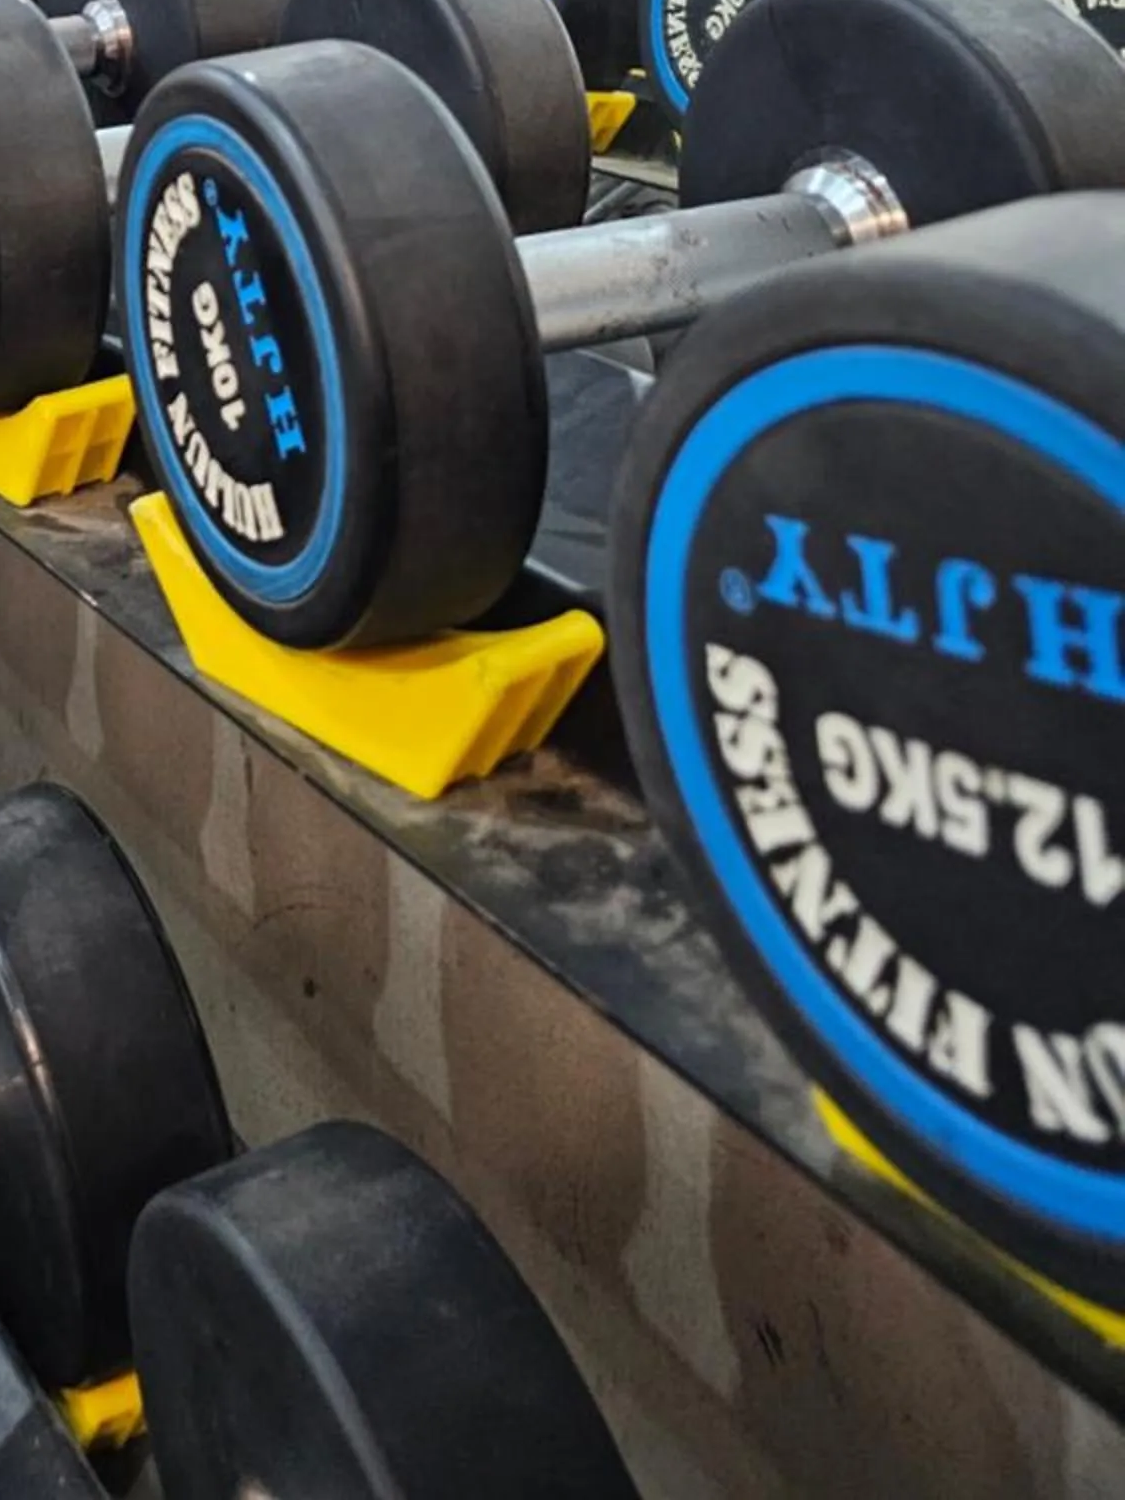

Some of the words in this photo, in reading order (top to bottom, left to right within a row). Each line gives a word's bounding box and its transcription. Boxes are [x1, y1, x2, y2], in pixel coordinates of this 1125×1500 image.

[147, 172, 201, 380] FITNESS
[191, 280, 246, 431] 10KG
[216, 208, 306, 459] HJTY
[705, 642, 993, 1099] FITNESS
[815, 711, 1125, 904] 12.5KG
